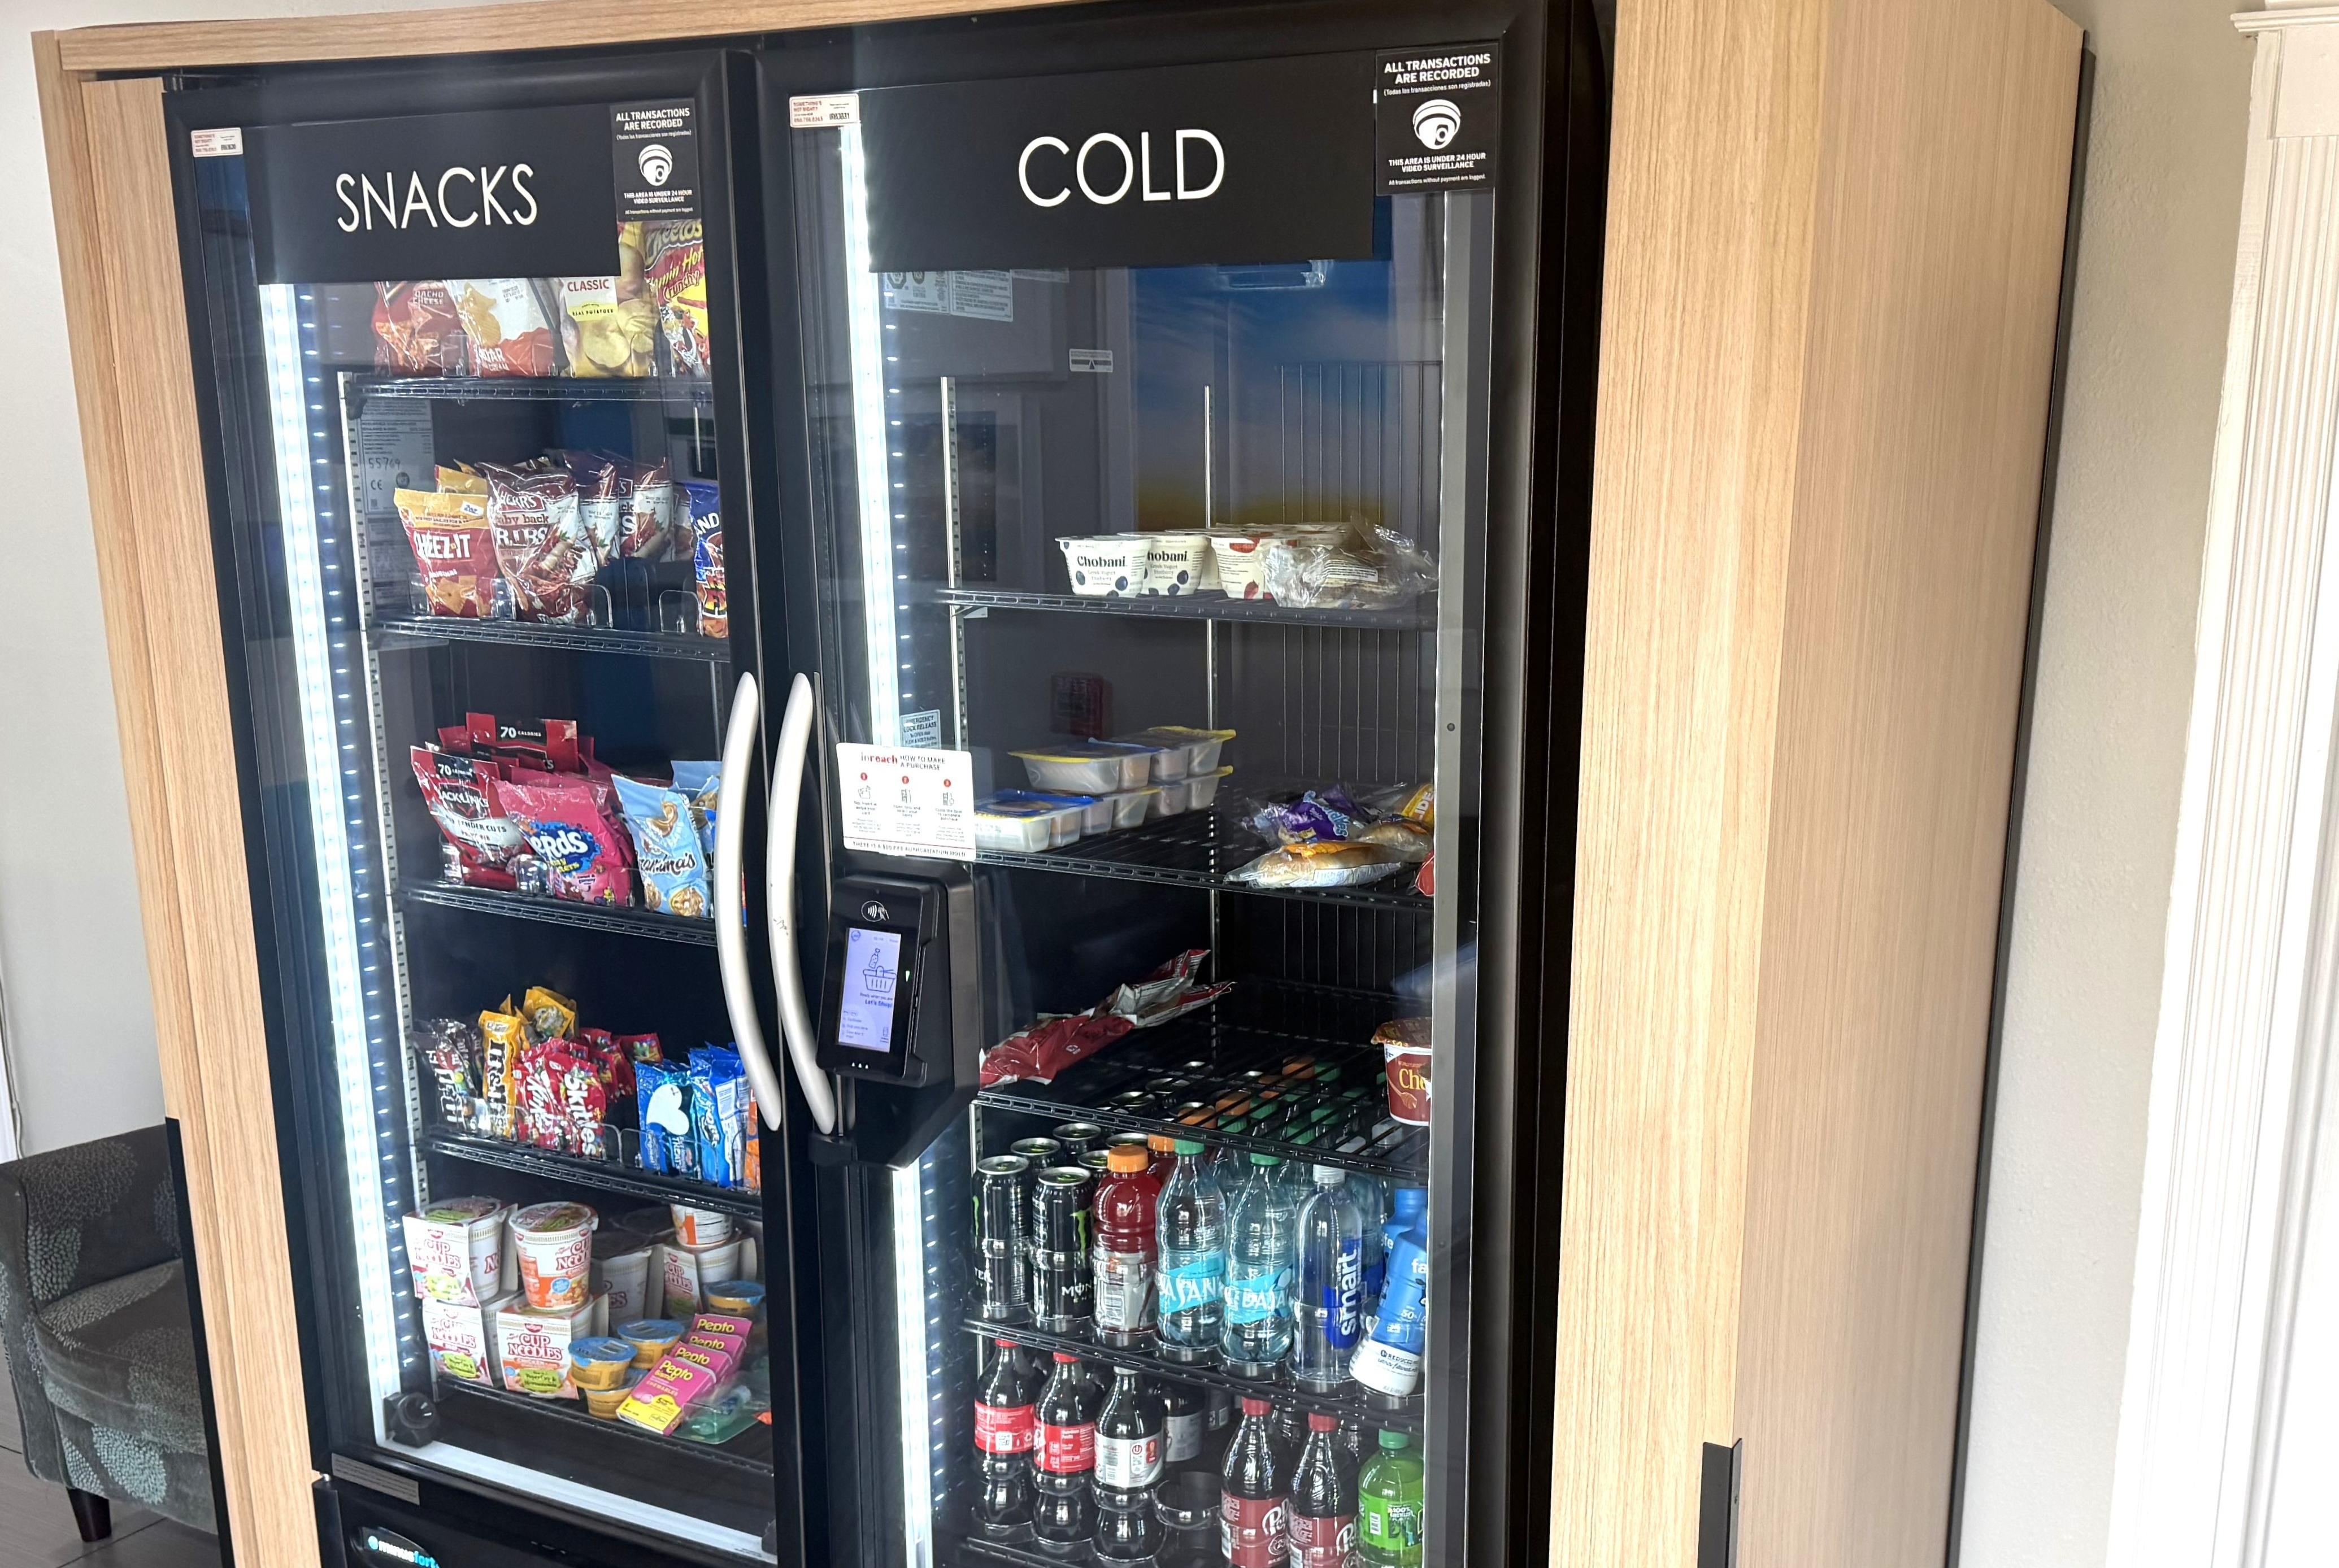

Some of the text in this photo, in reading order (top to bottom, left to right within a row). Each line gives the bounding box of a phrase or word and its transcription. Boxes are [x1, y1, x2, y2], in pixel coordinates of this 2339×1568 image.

[1384, 54, 1490, 73] ALL TRANSACTIONS
[1395, 67, 1479, 84] ARE RECORDED
[616, 108, 690, 121] ALL TRANSACTIONS
[624, 119, 683, 130] ARE RECORDED
[1019, 129, 1224, 207] COLD
[1423, 161, 1473, 171] SURVEILLANCE
[336, 164, 537, 233] SNACKS
[568, 279, 609, 291] CLASSIC
[663, 270, 700, 302] Crunchy
[371, 480, 382, 490] CE
[523, 513, 549, 524] back
[1077, 556, 1126, 567] Chobani
[1147, 551, 1188, 561] hobani
[501, 726, 516, 738] 70
[438, 764, 451, 776] 70
[1337, 1248, 1357, 1336] smart
[697, 1318, 735, 1333] Pepto
[519, 1333, 550, 1347] CUP
[689, 1336, 725, 1349] Pepto
[508, 1343, 563, 1361] NOODLES
[675, 1347, 710, 1365] Pepto
[659, 1360, 693, 1381] Pepto
[378, 1540, 441, 1568] minusfort
